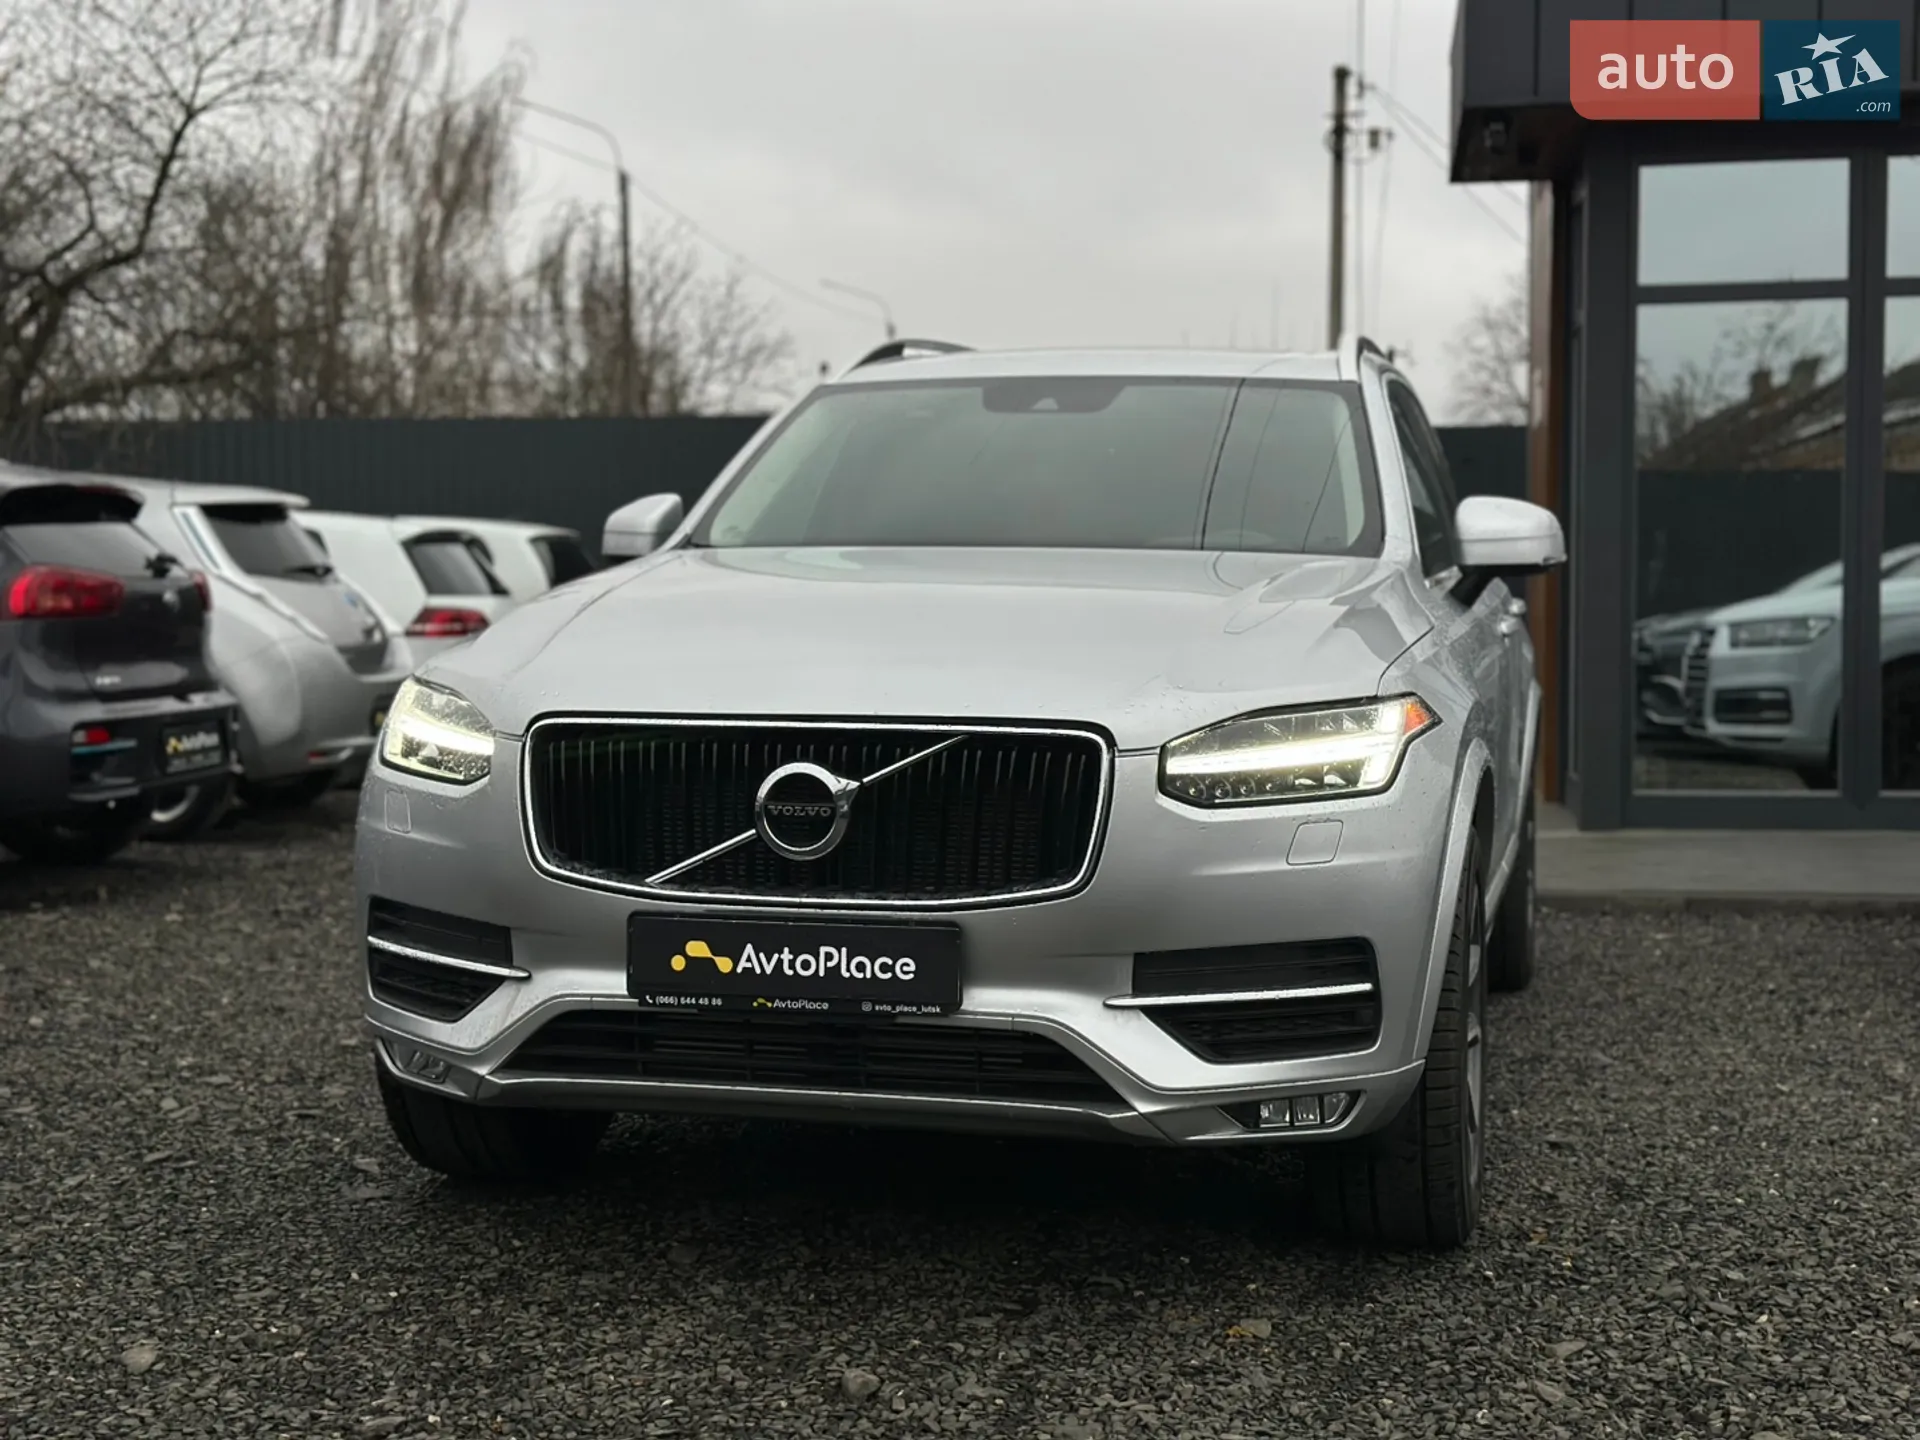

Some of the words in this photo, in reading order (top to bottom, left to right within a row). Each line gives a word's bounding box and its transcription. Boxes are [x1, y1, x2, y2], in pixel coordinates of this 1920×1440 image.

[767, 805, 831, 816] VOLVO
[736, 943, 916, 980] AvtoPlace
[773, 999, 829, 1010] AvtoPlace
